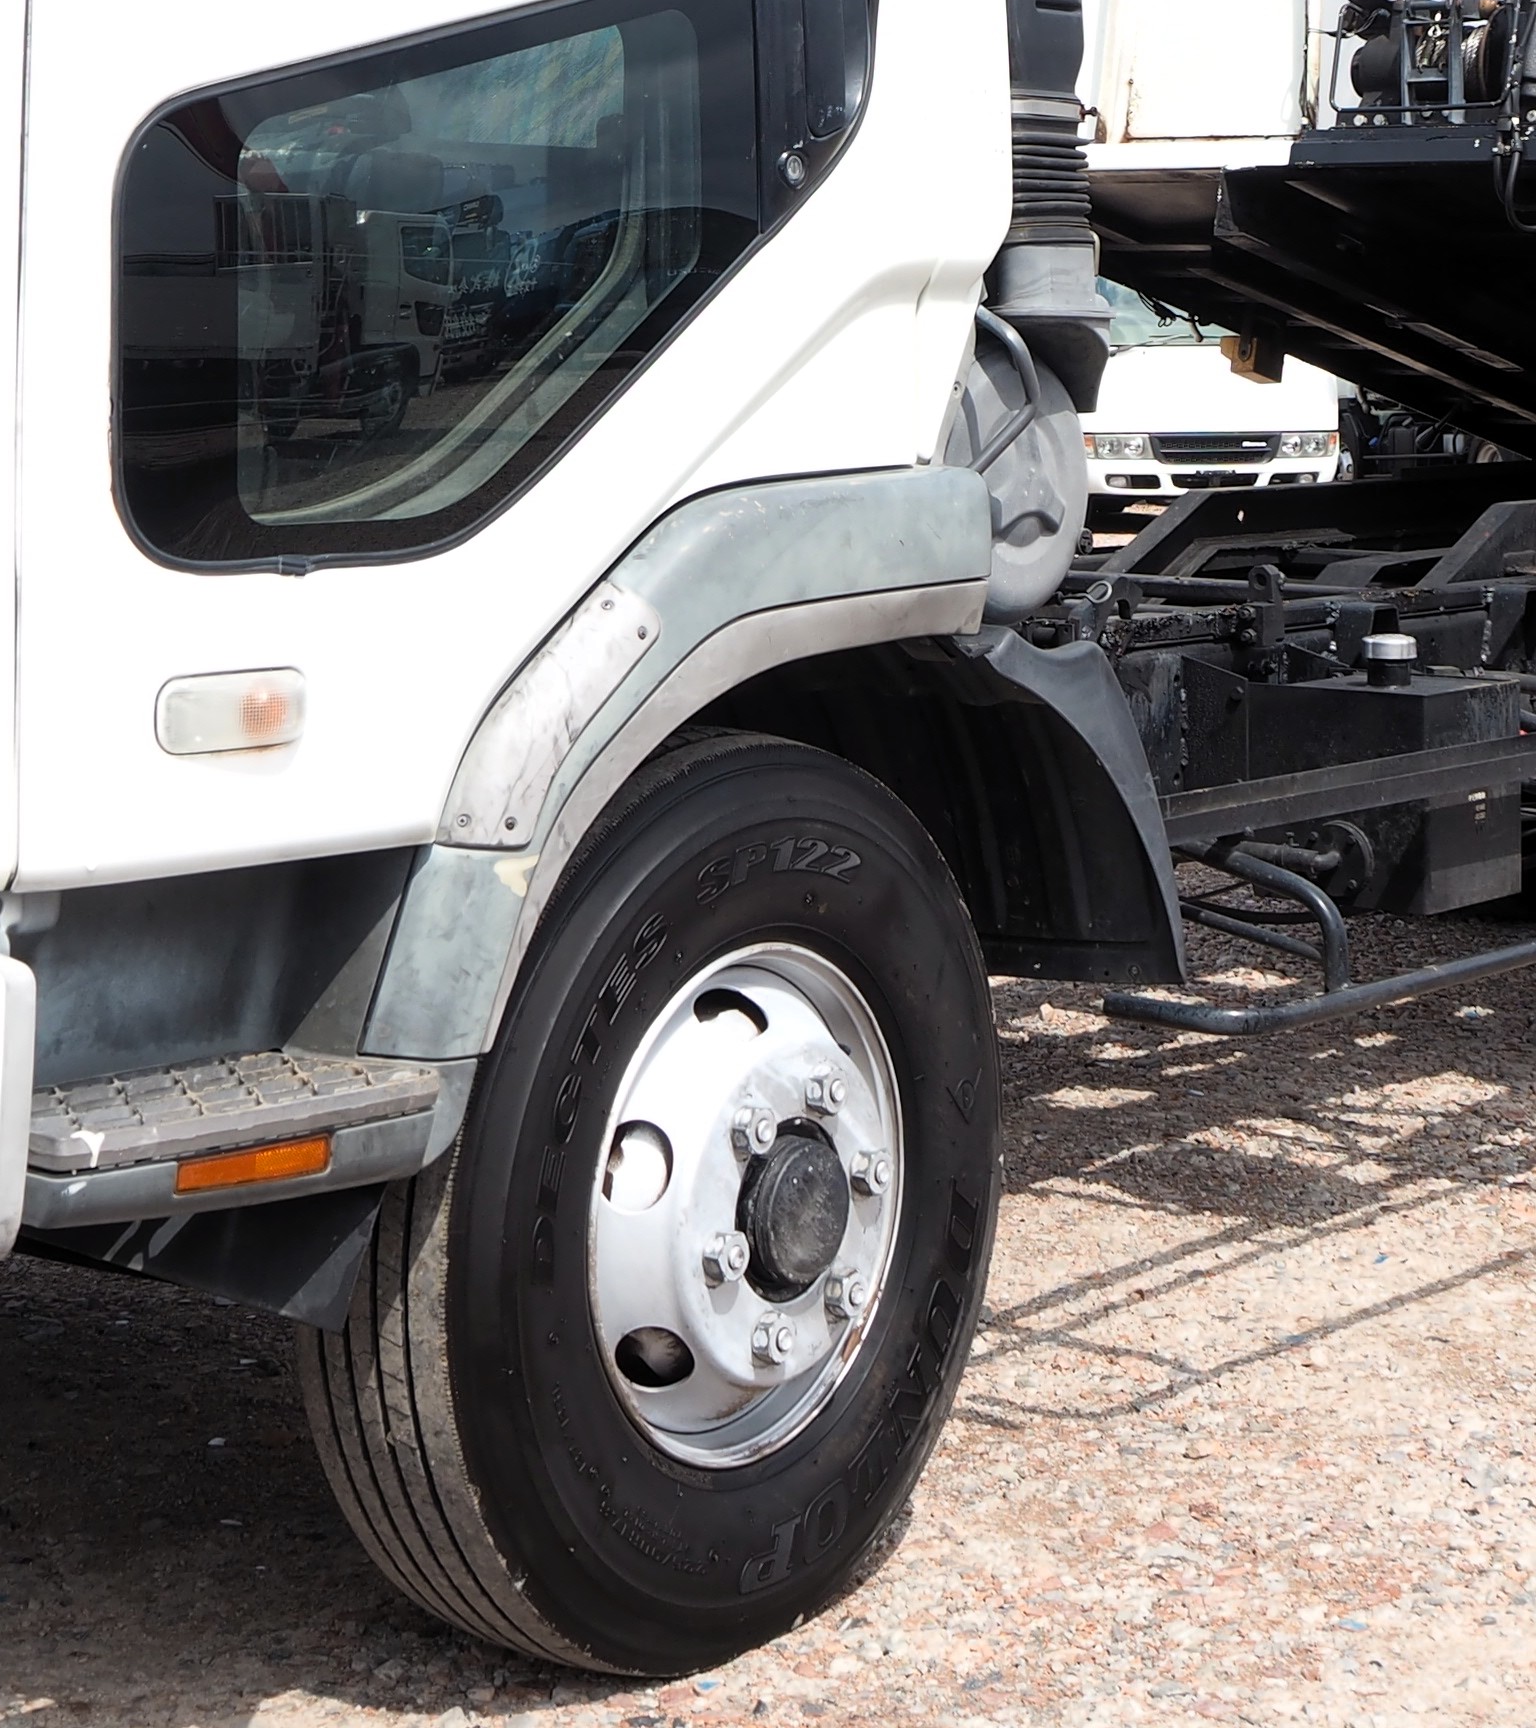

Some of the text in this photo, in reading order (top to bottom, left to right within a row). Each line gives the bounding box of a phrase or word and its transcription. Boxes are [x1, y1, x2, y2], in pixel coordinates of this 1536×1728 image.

[531, 836, 863, 1287] DECTES SP122
[738, 1177, 980, 1595] DUNLOP
